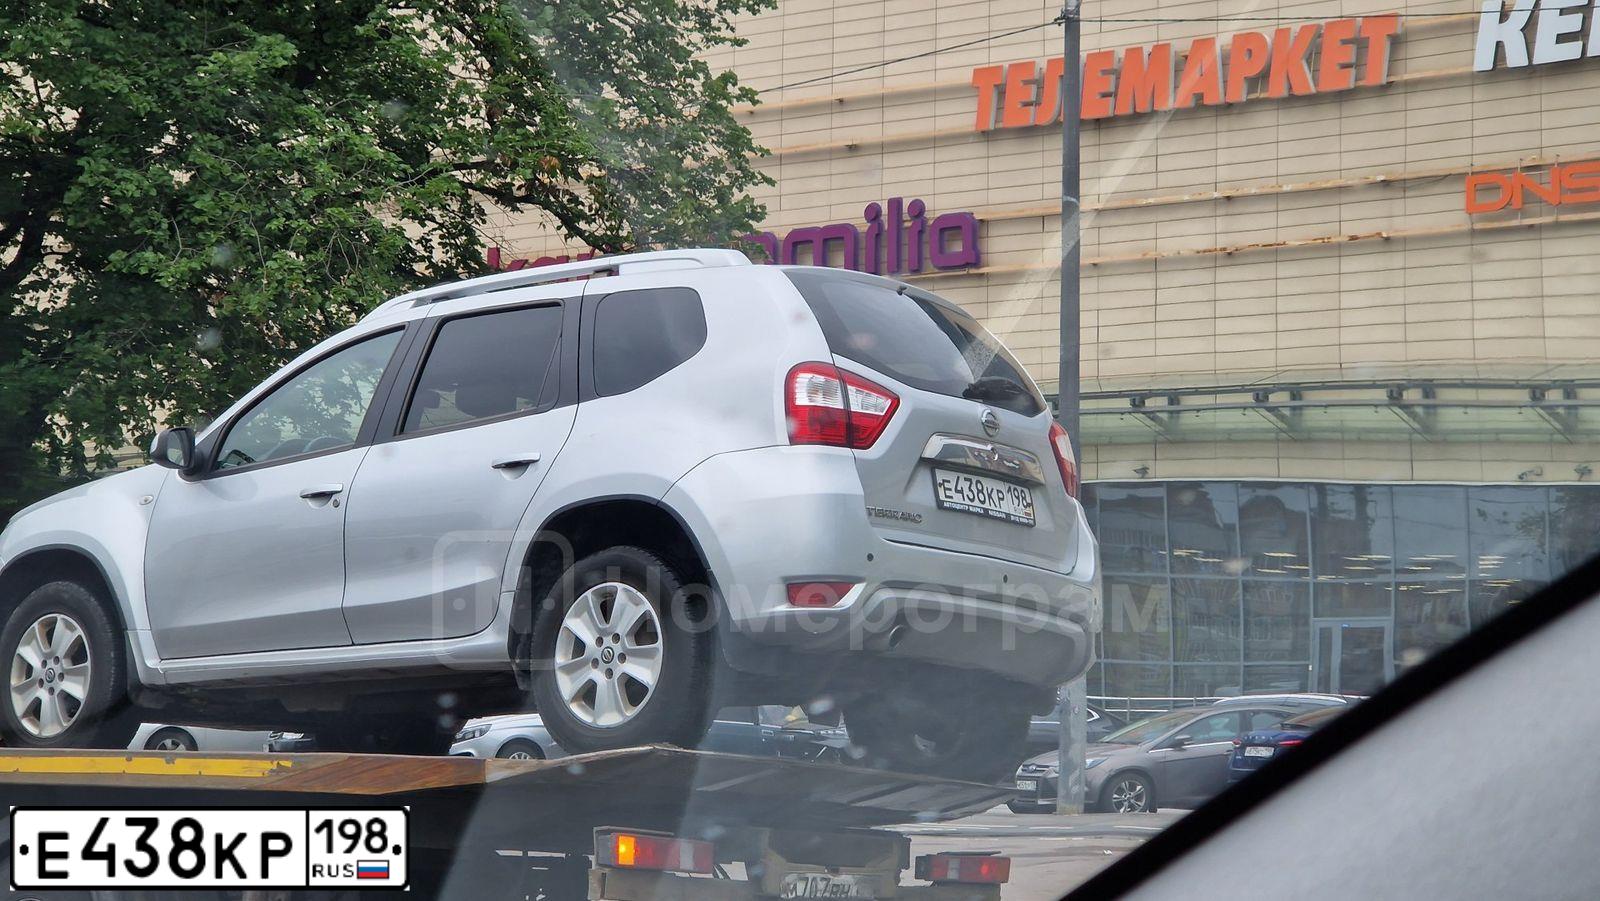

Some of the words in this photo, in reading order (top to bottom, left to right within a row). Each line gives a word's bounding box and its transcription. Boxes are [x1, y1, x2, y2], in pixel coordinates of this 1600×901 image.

[972, 13, 1400, 131] ТЕЛЕМАРКЕТ
[1466, 160, 1600, 213] DNS
[942, 475, 1005, 509] Е438КР
[1007, 486, 1028, 509] 198
